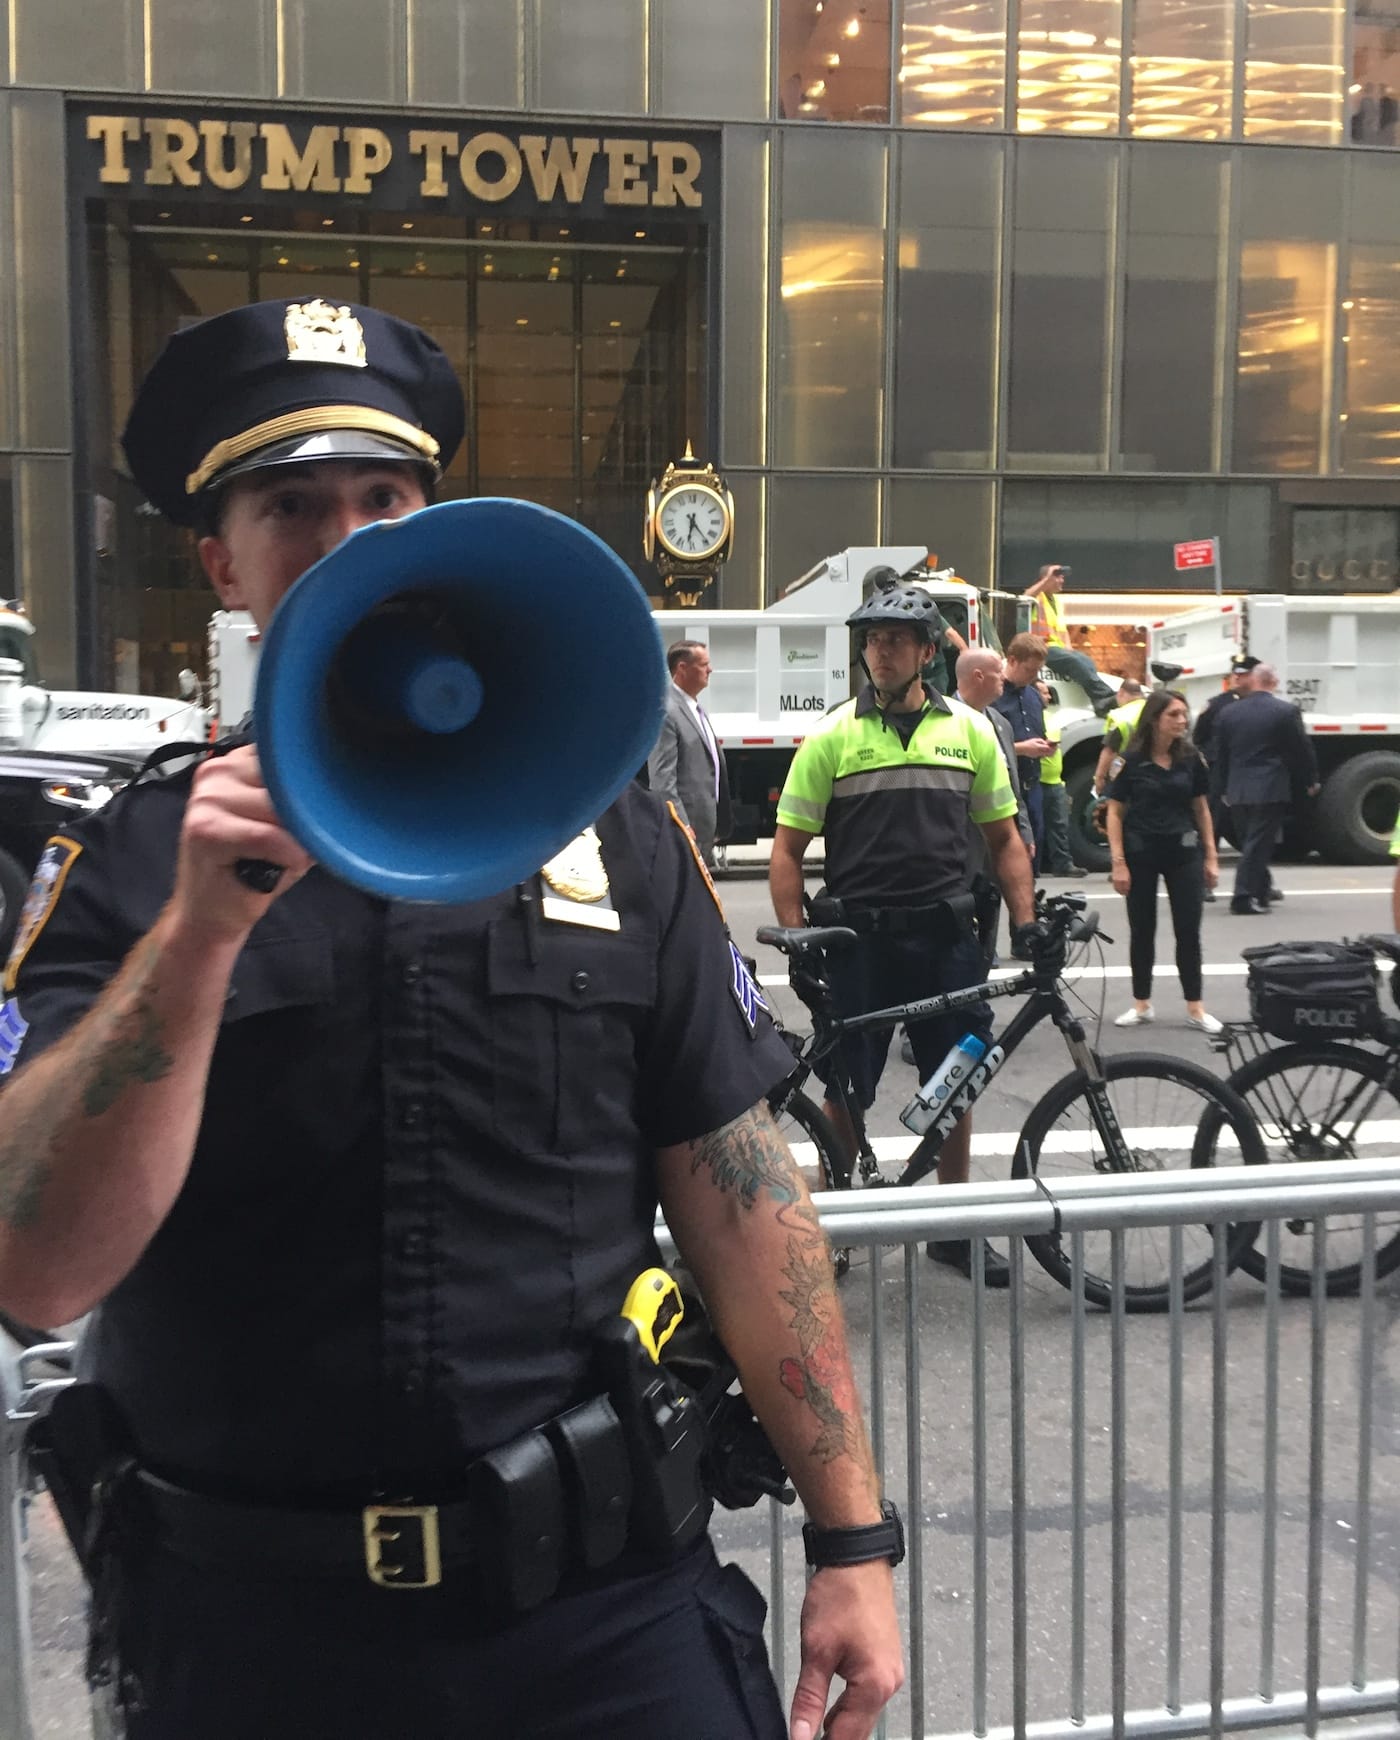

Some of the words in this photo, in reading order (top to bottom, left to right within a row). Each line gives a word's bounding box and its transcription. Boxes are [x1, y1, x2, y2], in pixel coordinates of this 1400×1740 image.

[86, 115, 393, 194] TRUMP
[408, 130, 703, 207] TOWER
[831, 669, 846, 680] 16.1
[56, 703, 150, 721] sanitation
[780, 695, 825, 712] M.Lots
[934, 745, 968, 760] POLICE
[1294, 1007, 1358, 1028] POLICE
[927, 1064, 964, 1111] core
[936, 1044, 1006, 1141] NYPD
